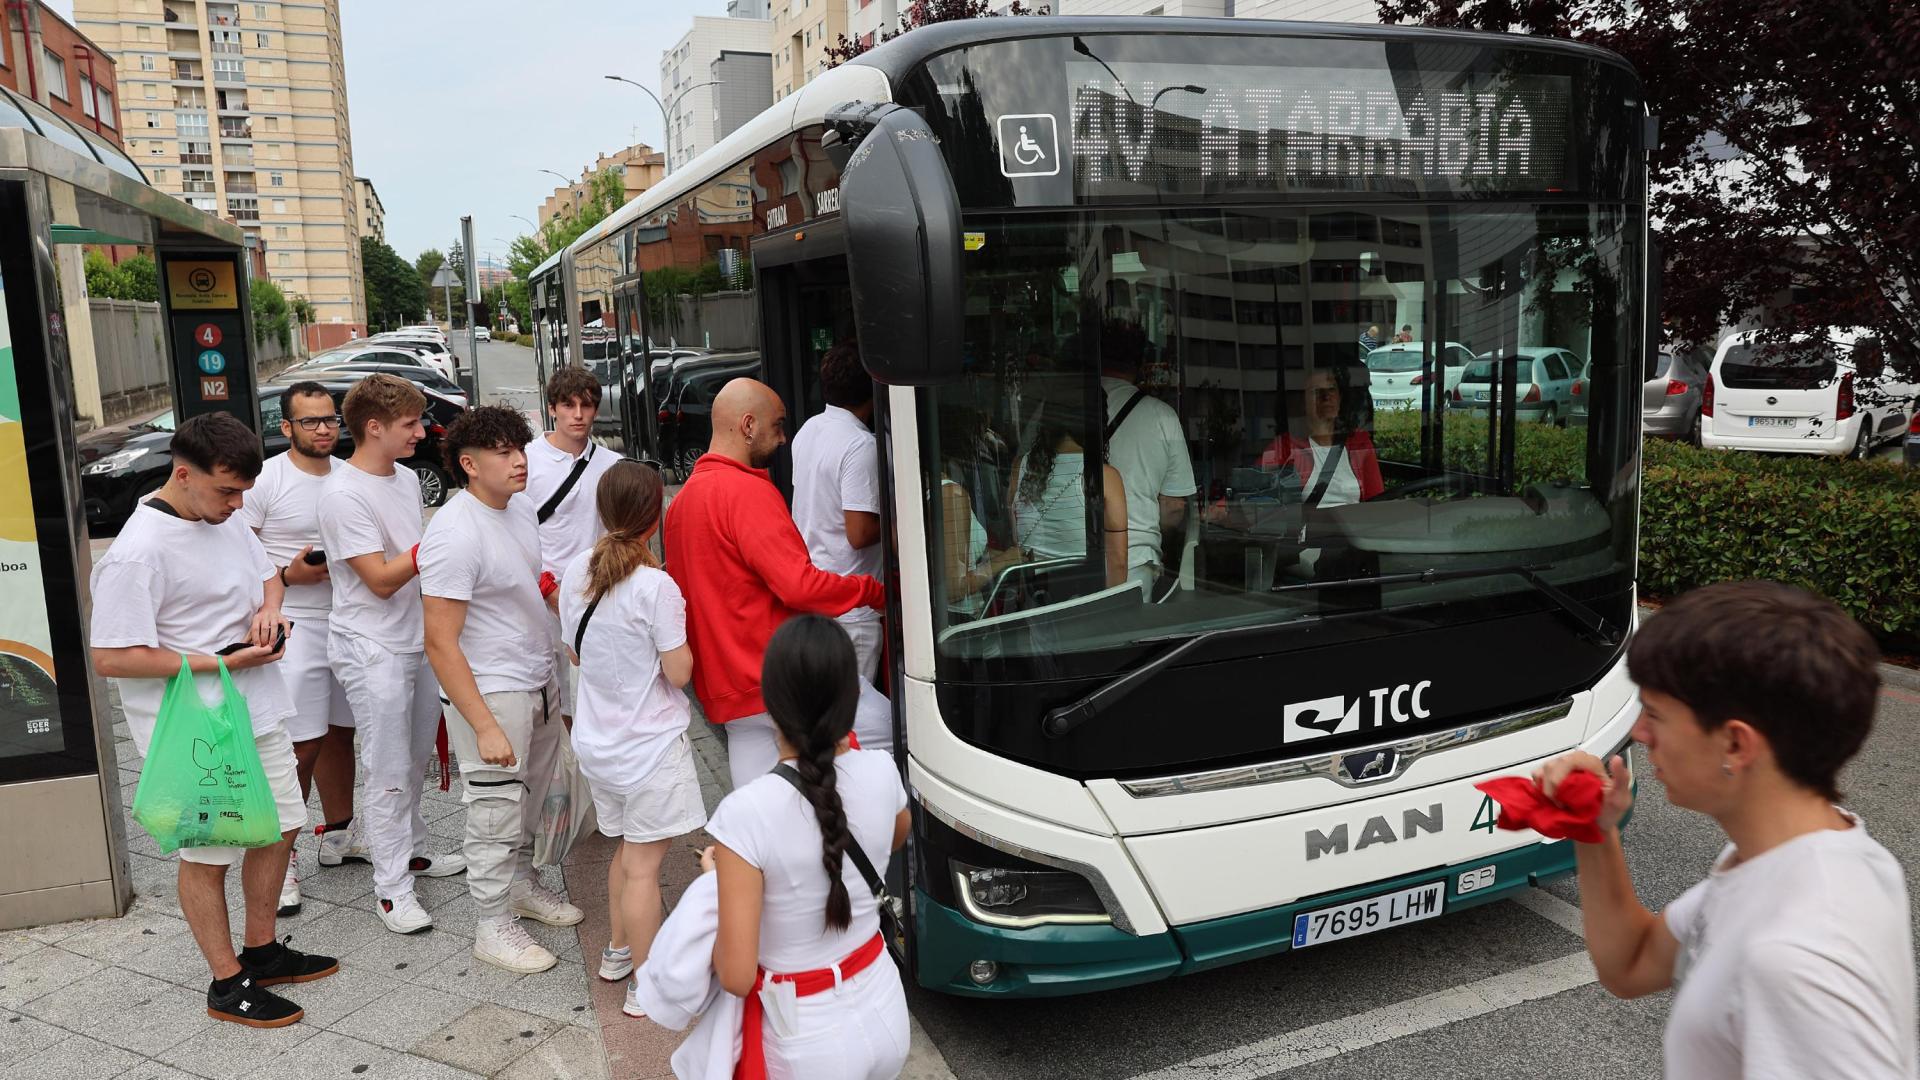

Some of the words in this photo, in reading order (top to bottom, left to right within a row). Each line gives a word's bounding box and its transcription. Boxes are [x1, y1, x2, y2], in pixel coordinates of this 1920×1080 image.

[1200, 88, 1532, 177] ATARRABIA
[816, 187, 841, 216] SARRER
[766, 203, 788, 231] ENTRADA
[203, 327, 214, 344] 4
[201, 353, 222, 370] 19
[203, 381, 226, 396] N2
[0, 562, 28, 572] boa
[1369, 679, 1432, 728] TCC
[26, 721, 50, 730] EDER
[1304, 802, 1444, 862] MAN
[1313, 901, 1380, 940] 7695
[1388, 887, 1438, 923] LHW
